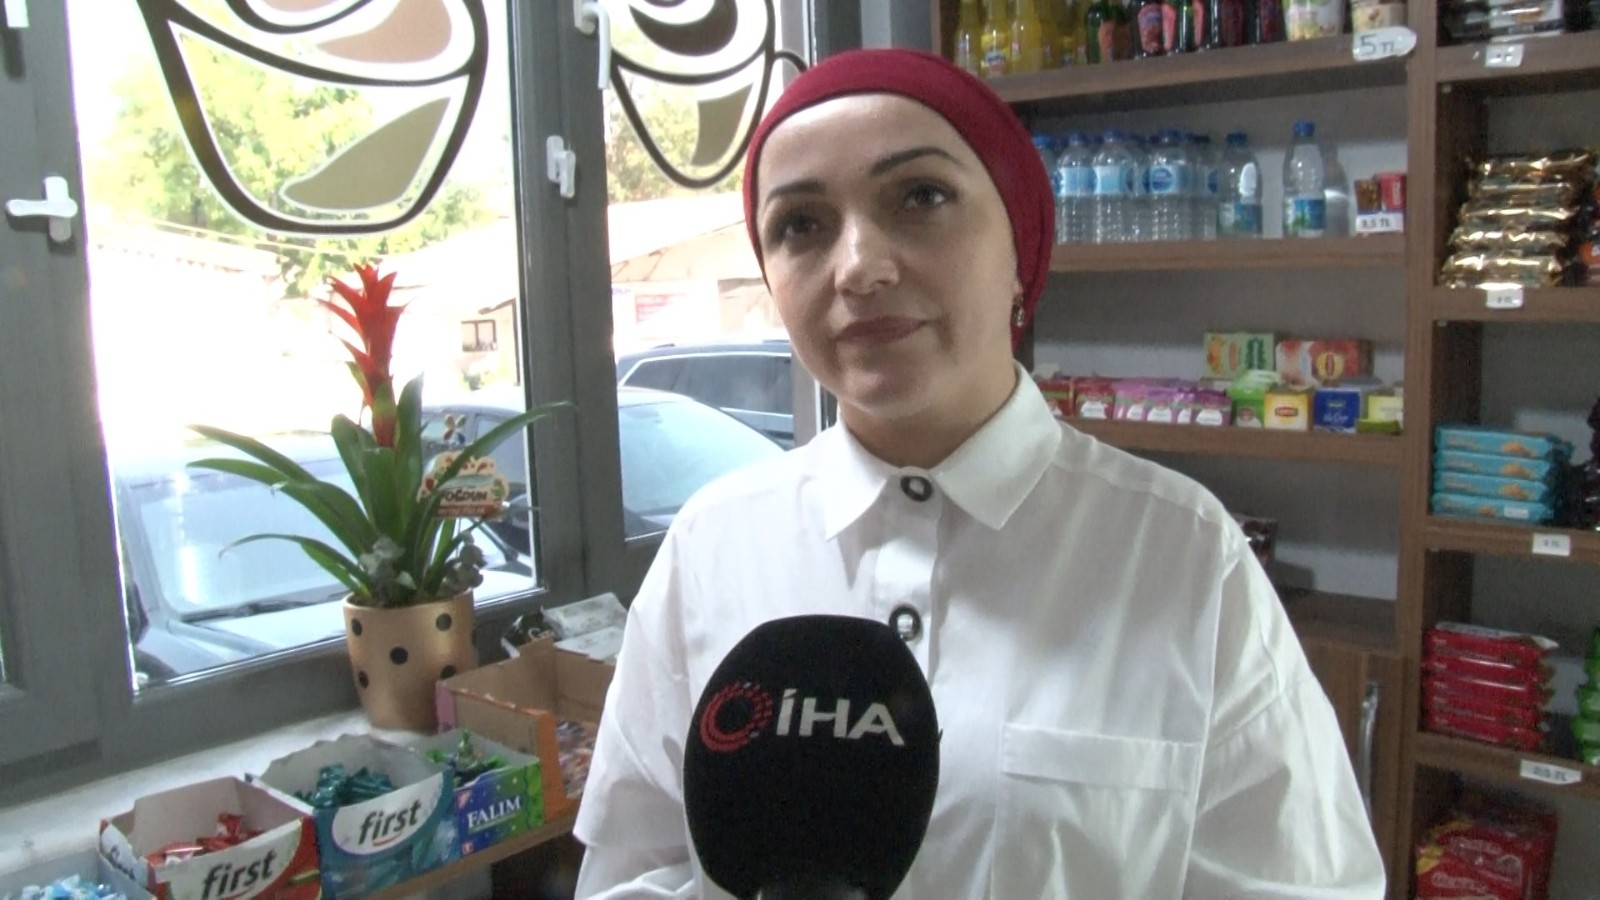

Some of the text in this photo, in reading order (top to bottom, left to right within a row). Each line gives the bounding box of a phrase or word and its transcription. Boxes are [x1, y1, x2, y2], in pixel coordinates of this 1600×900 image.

[1360, 33, 1377, 56] 5
[776, 688, 905, 746] İHA
[358, 799, 422, 845] first
[467, 795, 521, 828] FALIM
[202, 849, 278, 900] first
